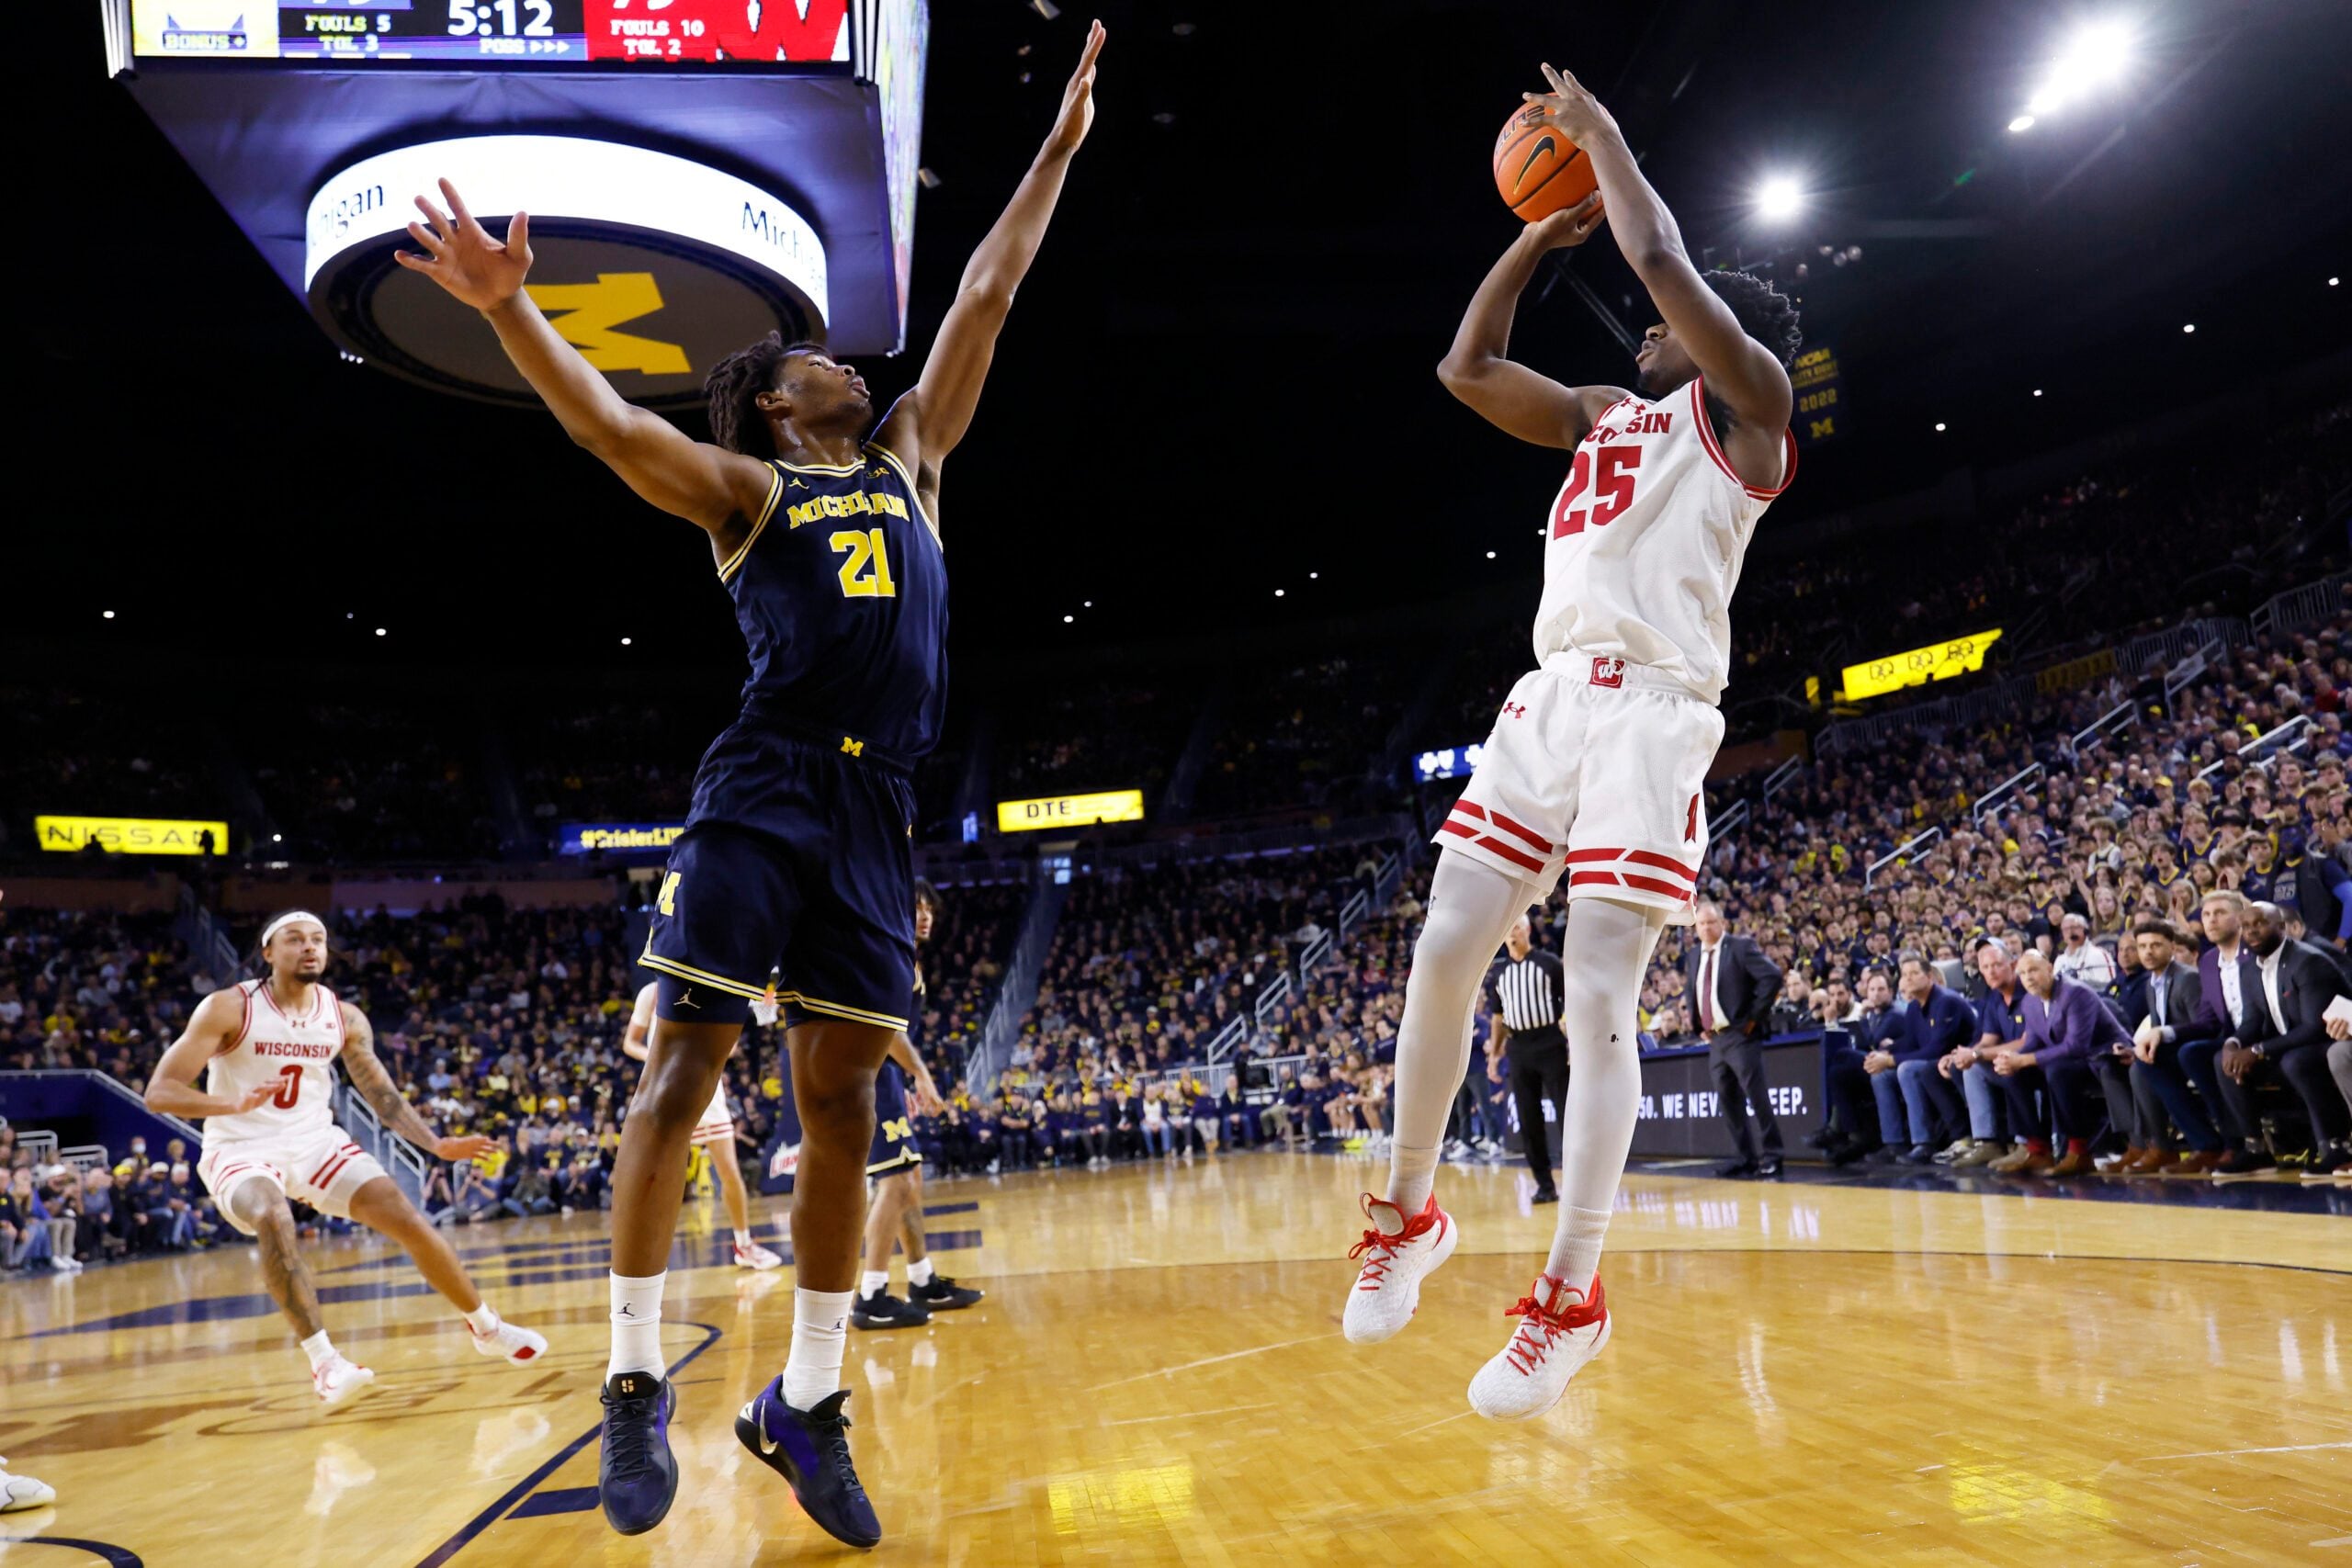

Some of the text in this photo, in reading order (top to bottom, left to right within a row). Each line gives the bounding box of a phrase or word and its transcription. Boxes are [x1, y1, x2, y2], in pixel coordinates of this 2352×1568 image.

[305, 14, 391, 33] FOULS 5
[447, 0, 554, 36] 5:12
[610, 19, 705, 37] FOULS 10
[164, 33, 230, 49] BONUS
[365, 34, 379, 51] 3
[479, 38, 526, 54] POSS
[667, 39, 682, 55] 2
[1810, 417, 1834, 438] M
[1554, 445, 1643, 540] 25
[829, 527, 896, 597] 21
[840, 737, 864, 757] M
[1026, 800, 1071, 818] DTE
[254, 1042, 333, 1058] WISCONSIN
[273, 1065, 303, 1109] 0
[1662, 1093, 1683, 1119] WE
[1688, 1091, 1724, 1118] NEV
[882, 1116, 912, 1143] M
